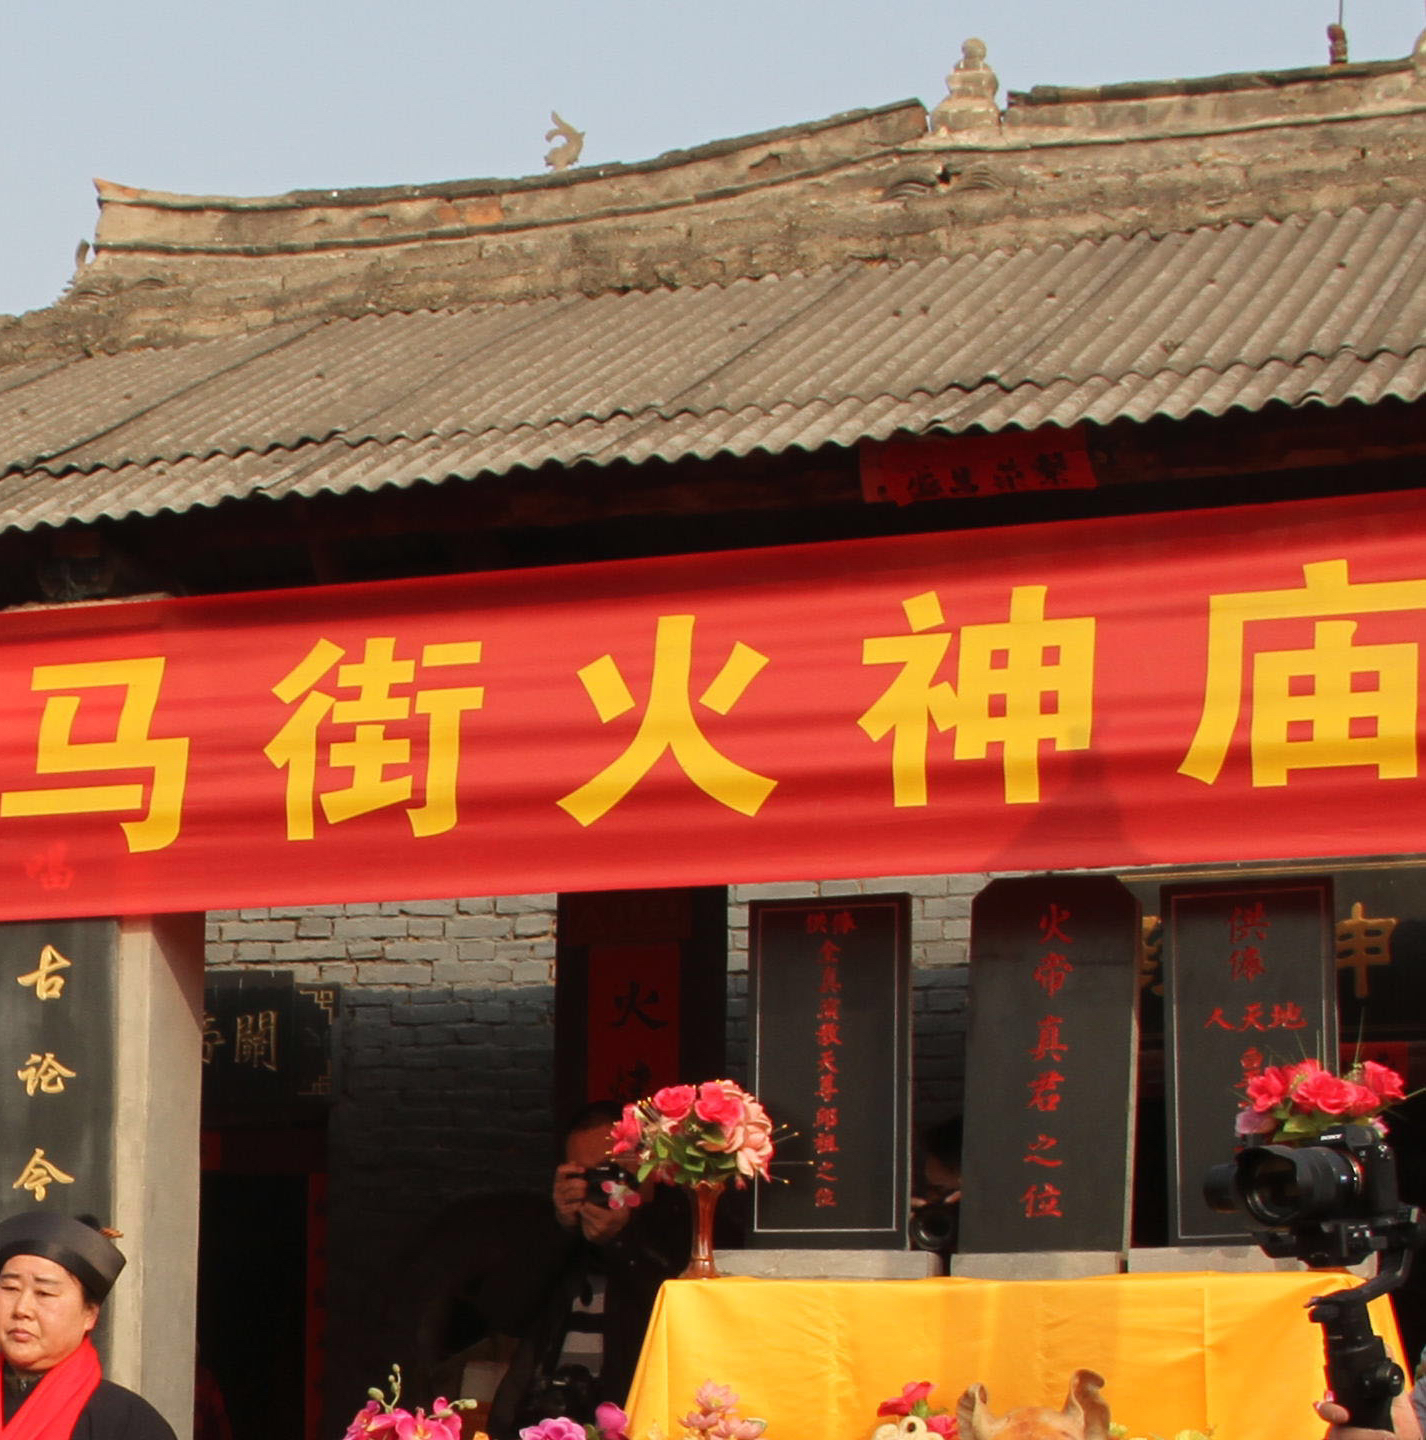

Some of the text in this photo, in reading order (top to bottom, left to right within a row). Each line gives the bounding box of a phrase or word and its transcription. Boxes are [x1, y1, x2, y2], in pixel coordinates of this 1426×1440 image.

[1020, 902, 1074, 1219] 火帝真君之位
